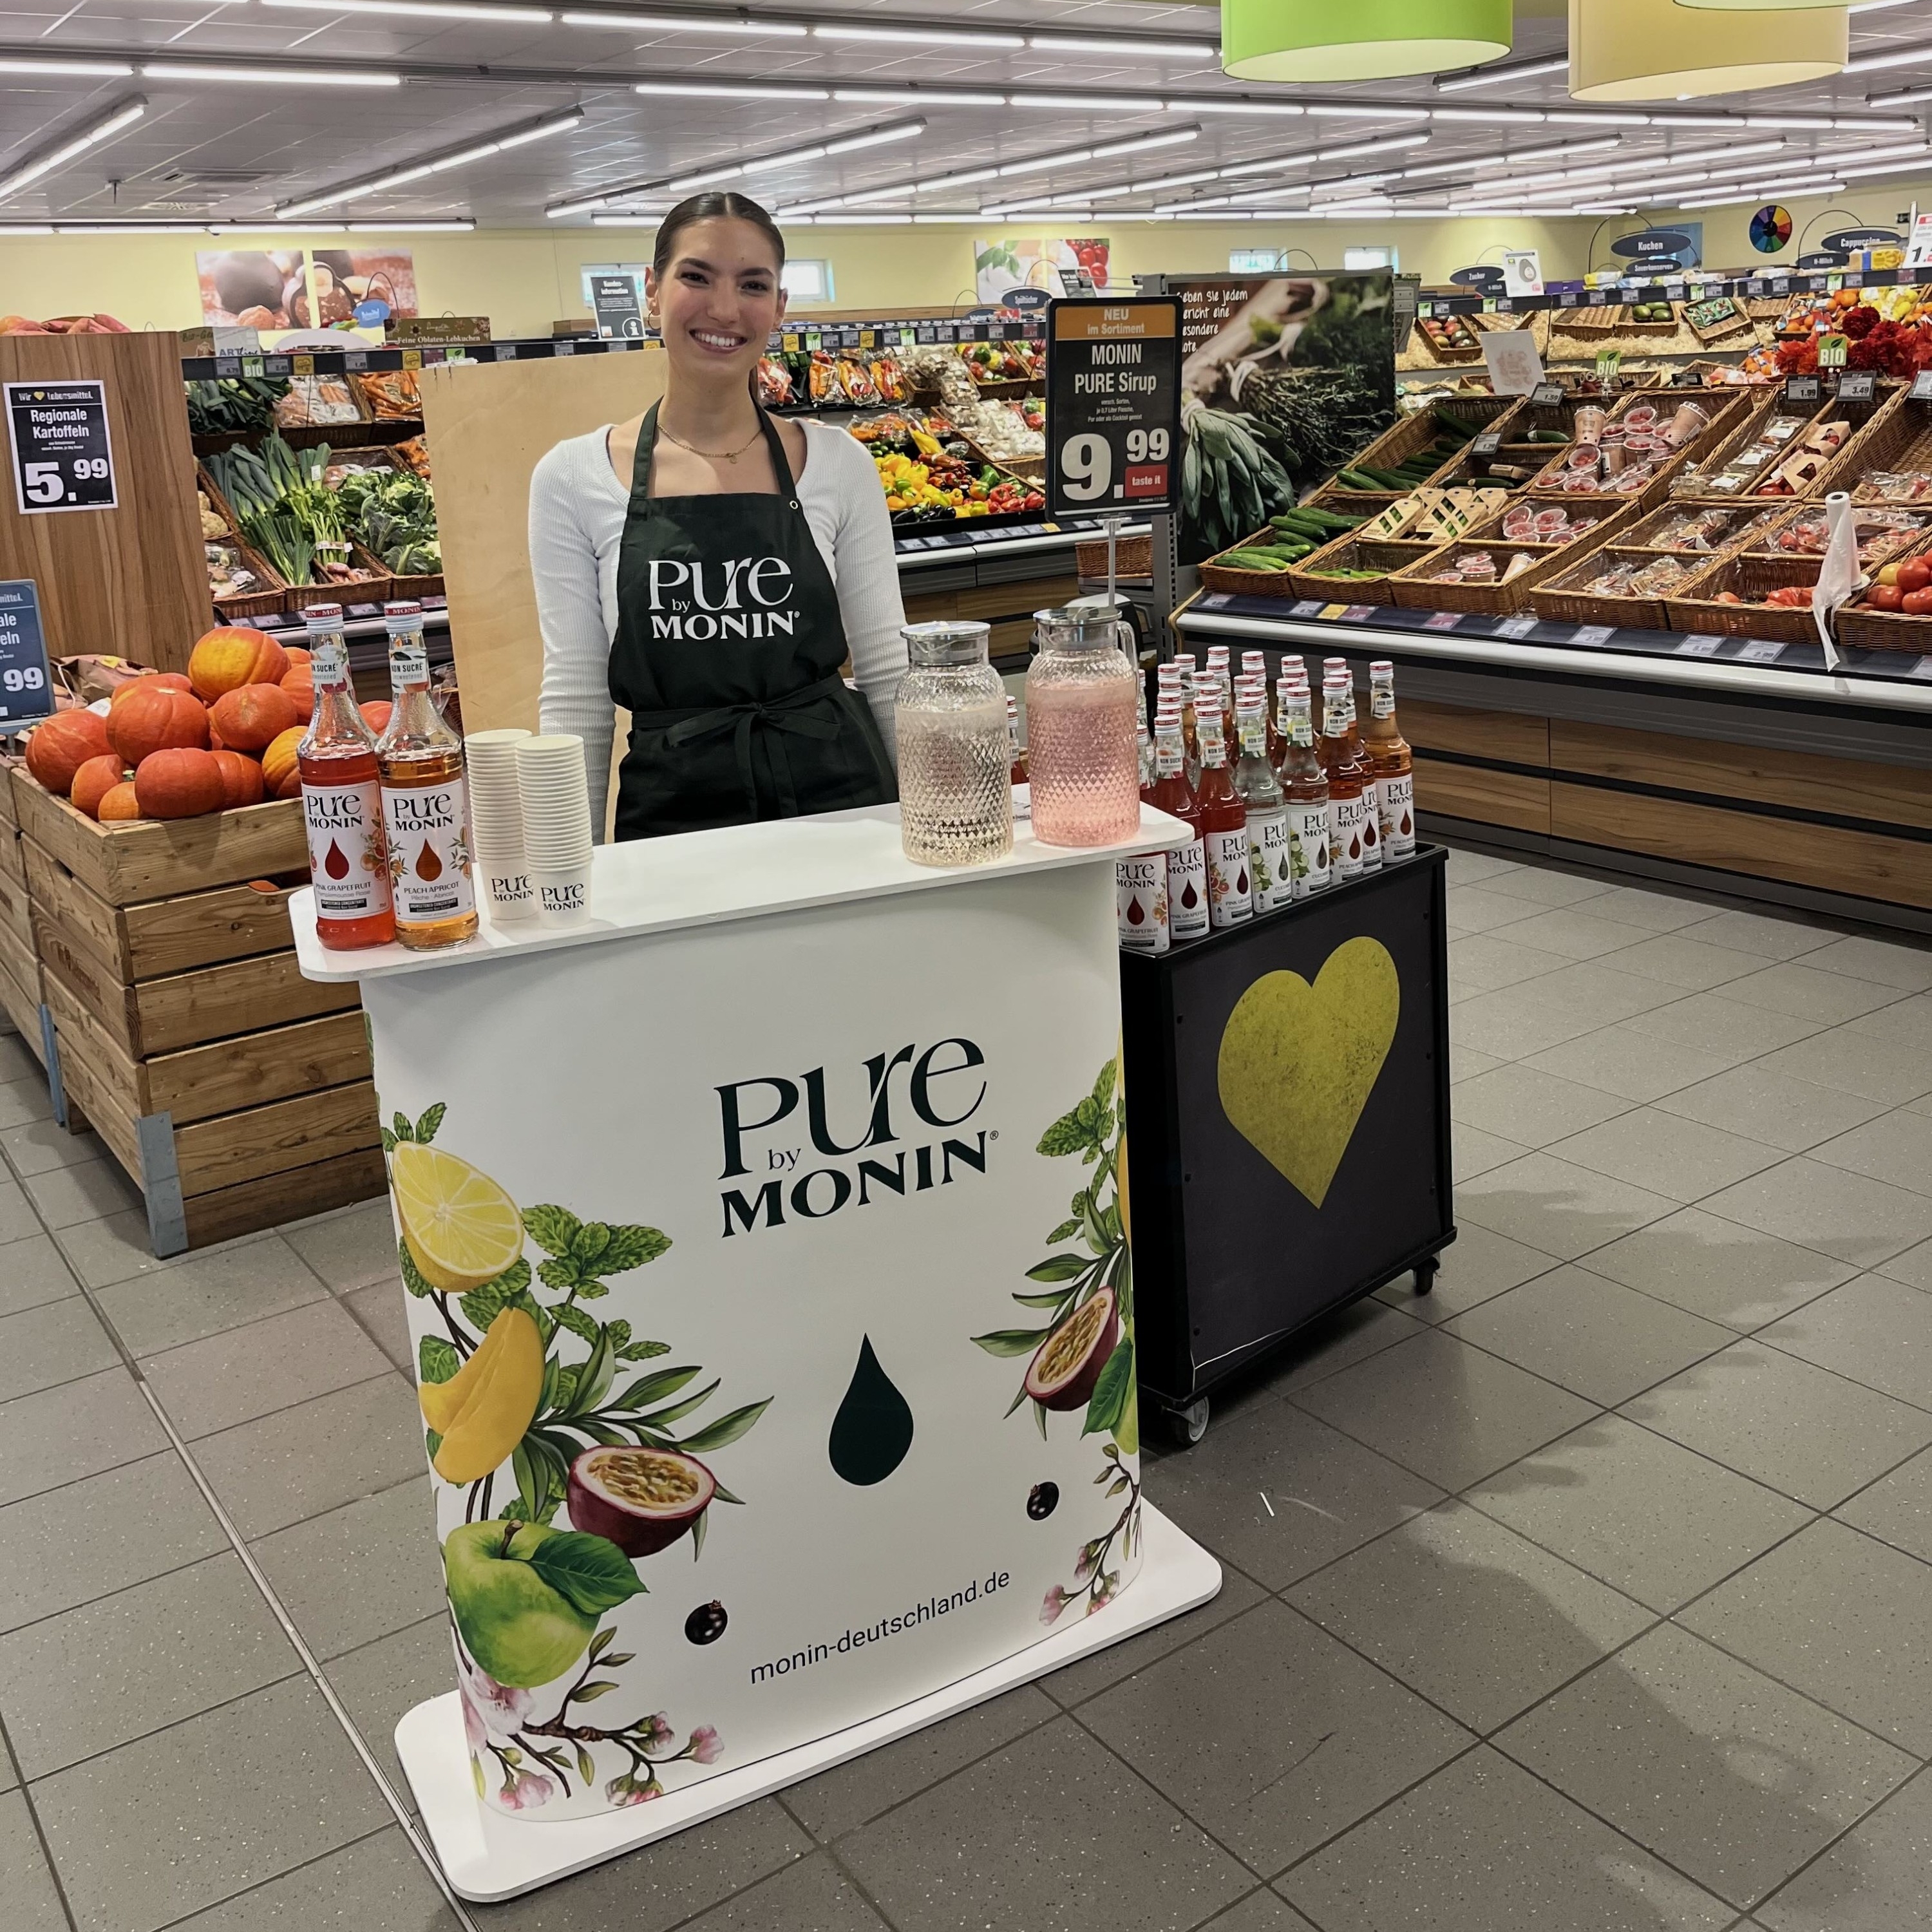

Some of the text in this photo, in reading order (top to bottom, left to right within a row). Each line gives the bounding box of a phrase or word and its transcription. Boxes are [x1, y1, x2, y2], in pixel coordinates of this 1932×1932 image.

[1206, 290, 1219, 302] Sie
[1221, 289, 1248, 307] jedem
[1104, 308, 1129, 321] NEU
[1183, 307, 1229, 319] ericht eine
[1087, 323, 1145, 335] im Sortiment
[1182, 323, 1218, 336] esondere
[1092, 344, 1142, 365] MONIN
[1821, 348, 1844, 365] BIO
[245, 365, 263, 377] BIO
[1597, 361, 1617, 375] BIO
[1074, 372, 1157, 395] PURE Sirup
[30, 408, 87, 424] Regionale
[32, 424, 90, 439] Kartoffeln
[1132, 475, 1160, 486] taste it
[649, 556, 793, 611] Pure
[672, 598, 690, 613] by
[307, 794, 361, 817] Pure
[393, 793, 451, 819] Pure
[309, 815, 363, 829] MONIN
[395, 816, 453, 831] MONIN
[1116, 863, 1155, 880] Pure
[327, 882, 372, 891] GRAPEFRUIT
[429, 881, 459, 893] APRICOT
[1117, 878, 1155, 888] MONIN
[541, 883, 584, 902] Pure
[544, 899, 584, 911] MONIN
[714, 1037, 987, 1180] Pure
[768, 1148, 801, 1171] by
[751, 1571, 1010, 1685] monin-deutschland.de
